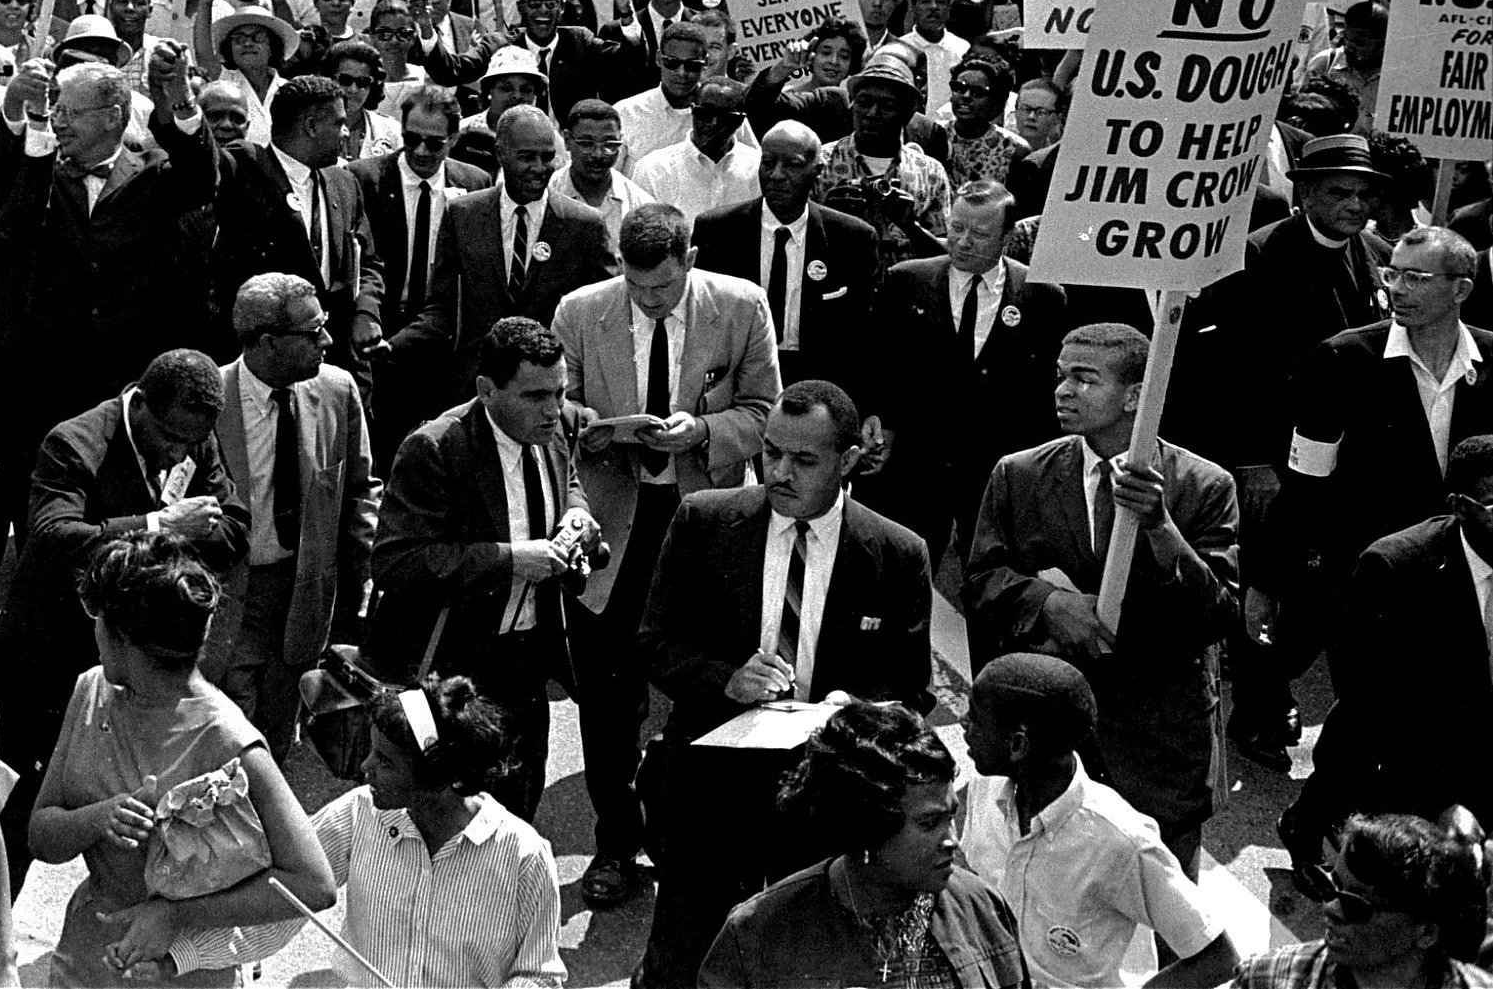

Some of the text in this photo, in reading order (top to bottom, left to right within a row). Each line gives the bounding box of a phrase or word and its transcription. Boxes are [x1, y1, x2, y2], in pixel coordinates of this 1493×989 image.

[739, 1, 849, 39] EVERYONE
[1090, 38, 1294, 104] U.S. DOUGH
[1439, 49, 1489, 91] FAIR
[1105, 113, 1263, 162] TO HELP
[1064, 153, 1261, 209] JIM CROW
[1094, 214, 1232, 260] GROW
